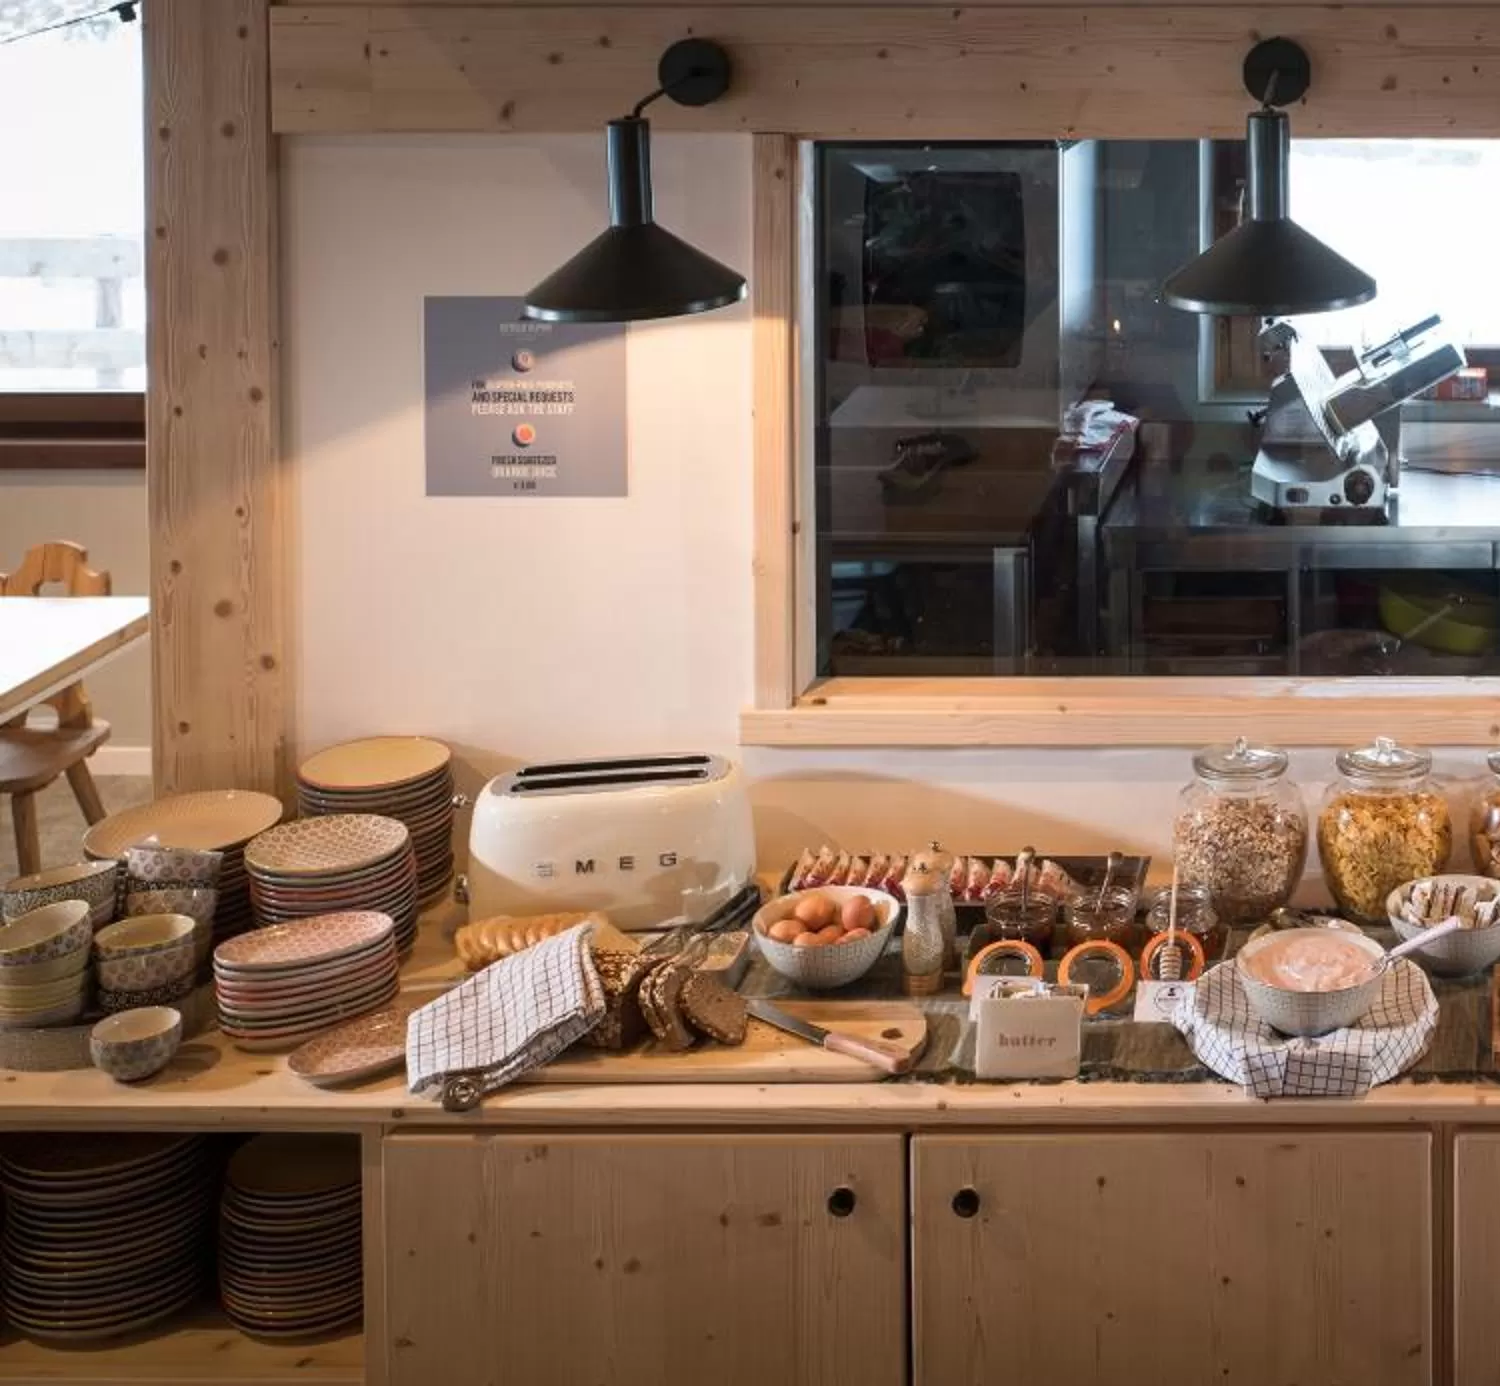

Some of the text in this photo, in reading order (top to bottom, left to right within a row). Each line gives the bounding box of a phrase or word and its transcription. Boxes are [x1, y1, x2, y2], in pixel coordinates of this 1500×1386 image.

[471, 391, 575, 402] AND SPECIAL REQUESTS
[532, 851, 678, 878] SMEG
[999, 1032, 1057, 1048] butter
